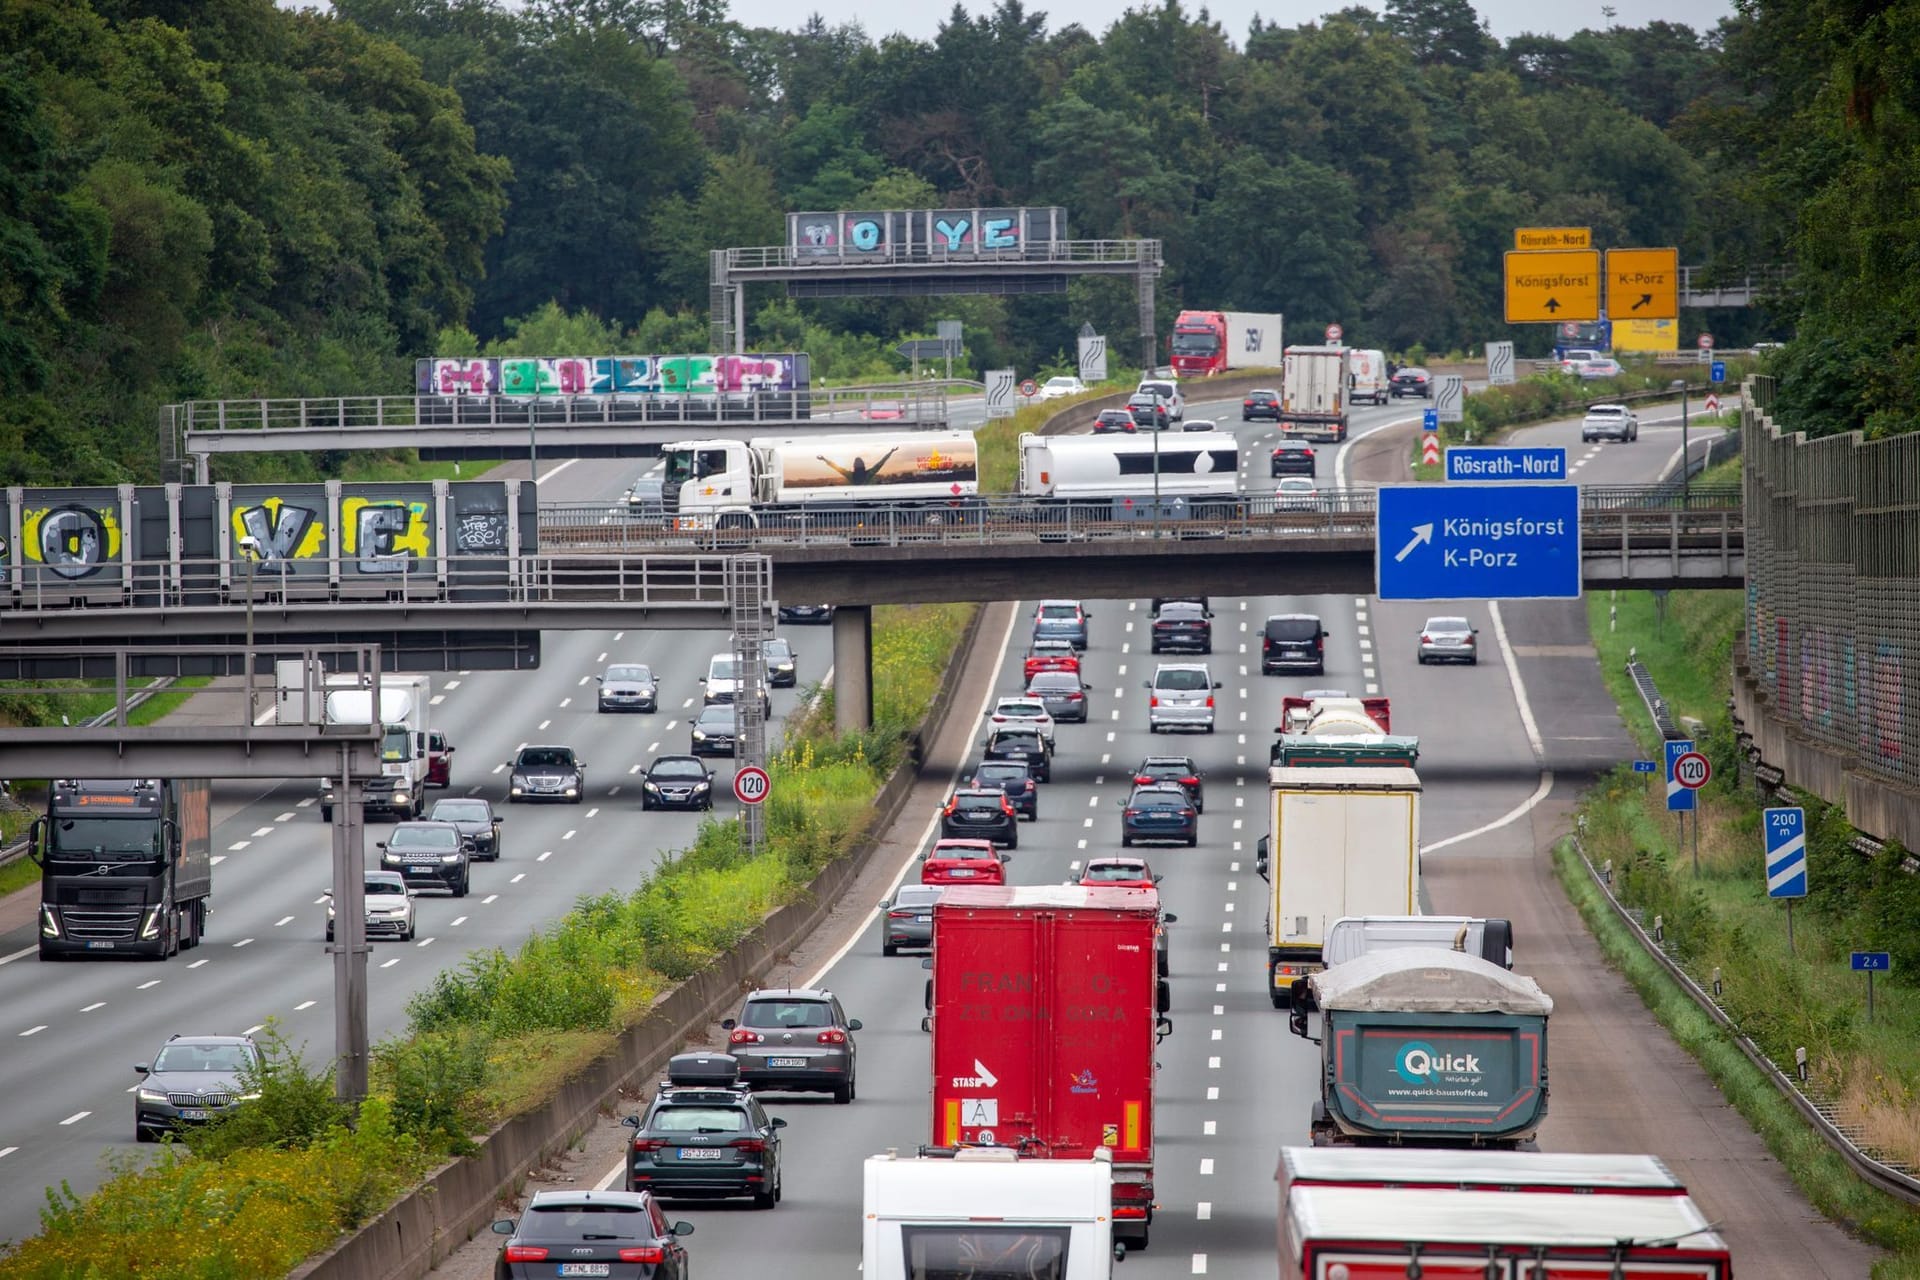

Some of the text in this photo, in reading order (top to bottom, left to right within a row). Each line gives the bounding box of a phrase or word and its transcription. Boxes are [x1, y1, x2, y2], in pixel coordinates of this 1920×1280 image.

[1515, 275, 1589, 290] Königsforst
[1619, 274, 1665, 285] K-Porz
[1453, 455, 1560, 474] Rösrath-Nord
[1443, 517, 1565, 540] Königsforst
[1443, 548, 1518, 567] K-Porz
[1672, 744, 1689, 755] 100
[1681, 762, 1704, 779] 120
[742, 777, 763, 793] 120
[1772, 813, 1797, 826] 200
[1779, 828, 1790, 836] m
[1863, 956, 1879, 968] 2.6
[1404, 1050, 1480, 1075] Quick
[1388, 1088, 1489, 1098] www.quick-baustoffe.de
[972, 1103, 988, 1122] A
[980, 1132, 993, 1144] 80
